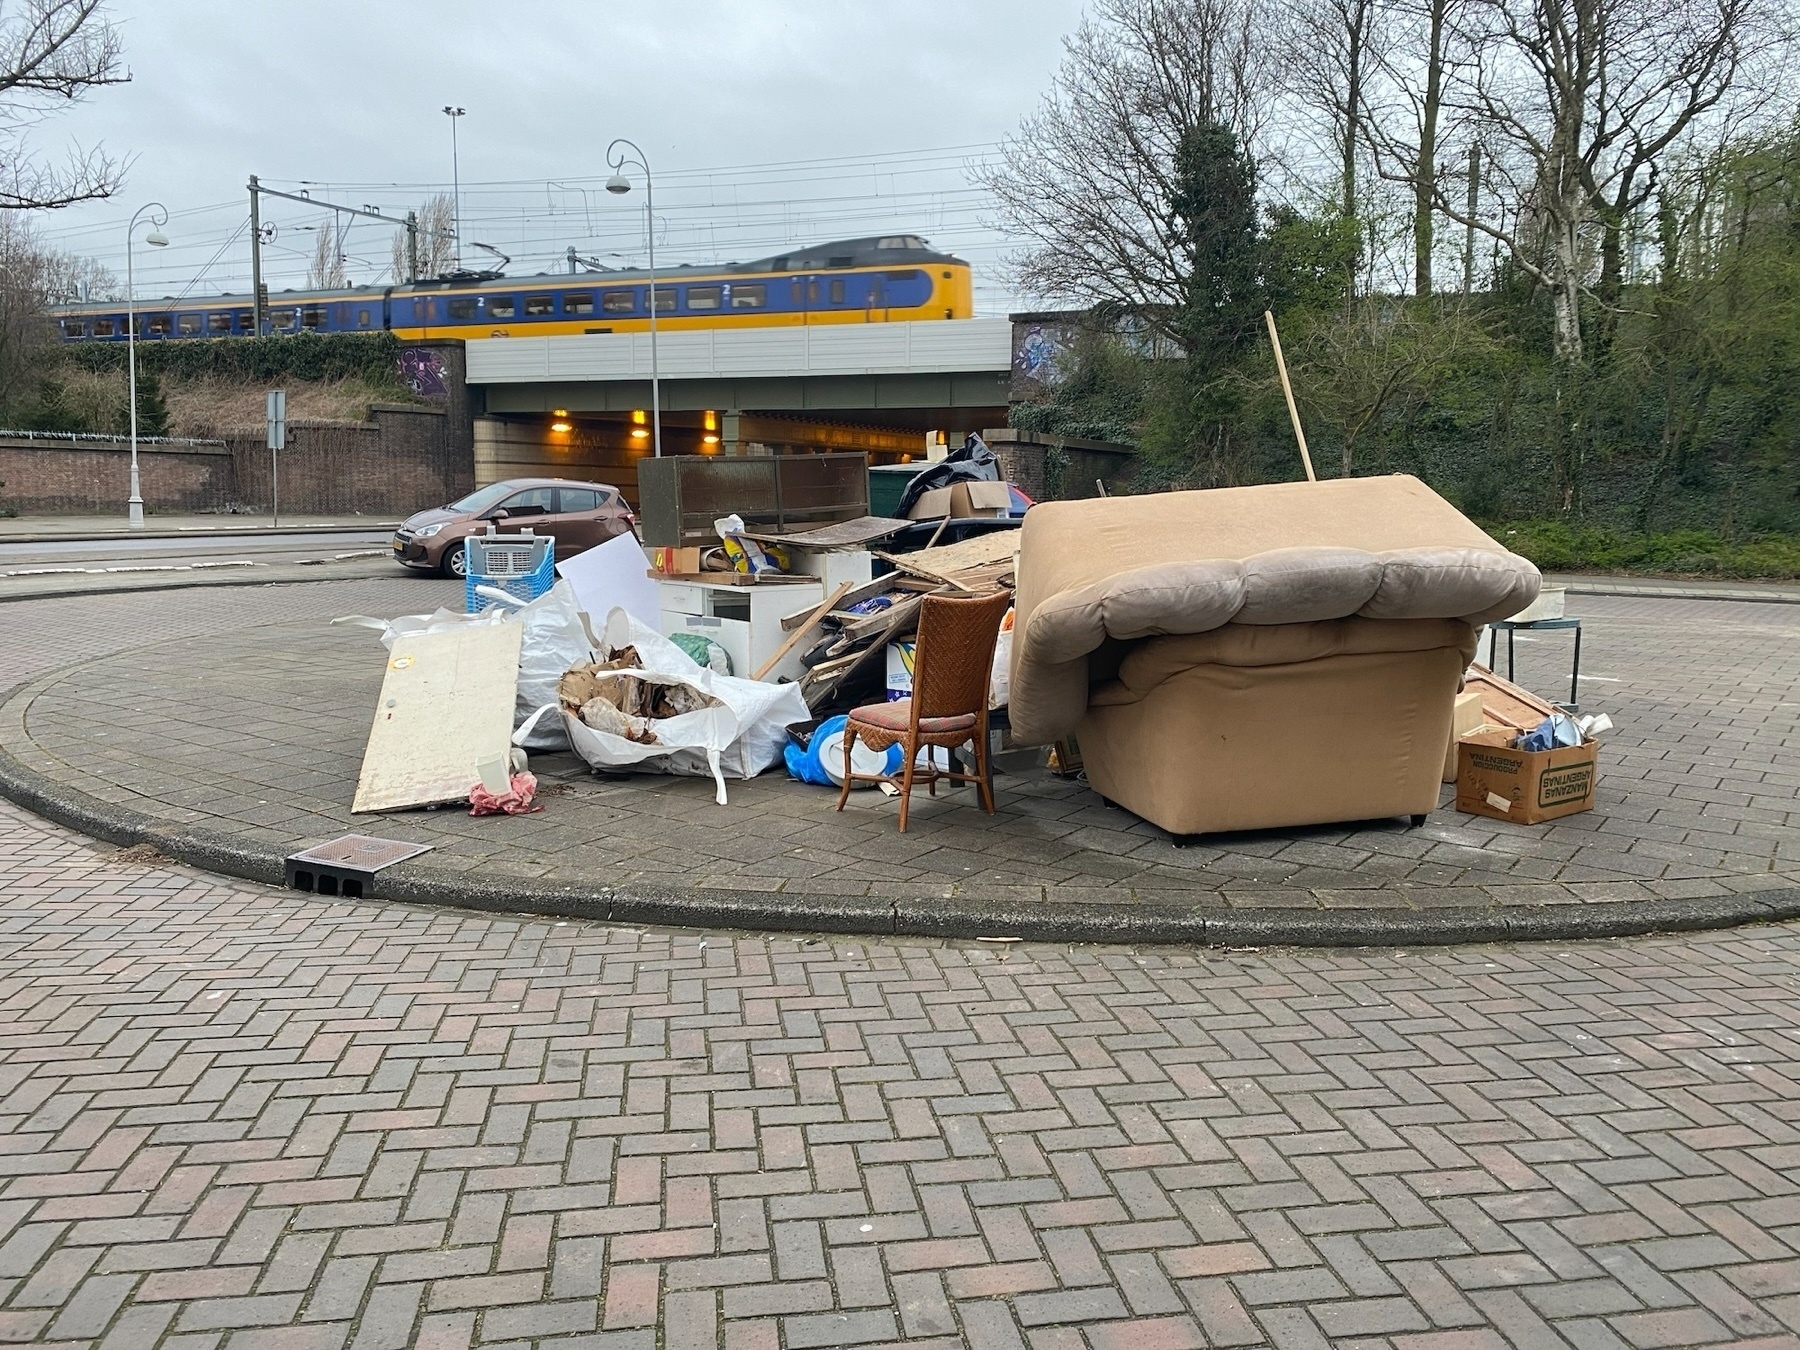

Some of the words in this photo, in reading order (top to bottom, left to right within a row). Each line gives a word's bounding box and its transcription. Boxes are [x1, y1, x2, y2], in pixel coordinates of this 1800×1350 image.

[722, 284, 731, 295] 2
[477, 297, 485, 307] 2
[295, 307, 302, 317] 2
[1469, 752, 1524, 768] ARGENTINA
[1472, 760, 1518, 775] PRODUCCION
[1543, 770, 1592, 788] ARGENTINAS
[1545, 780, 1588, 799] MANZANAS
